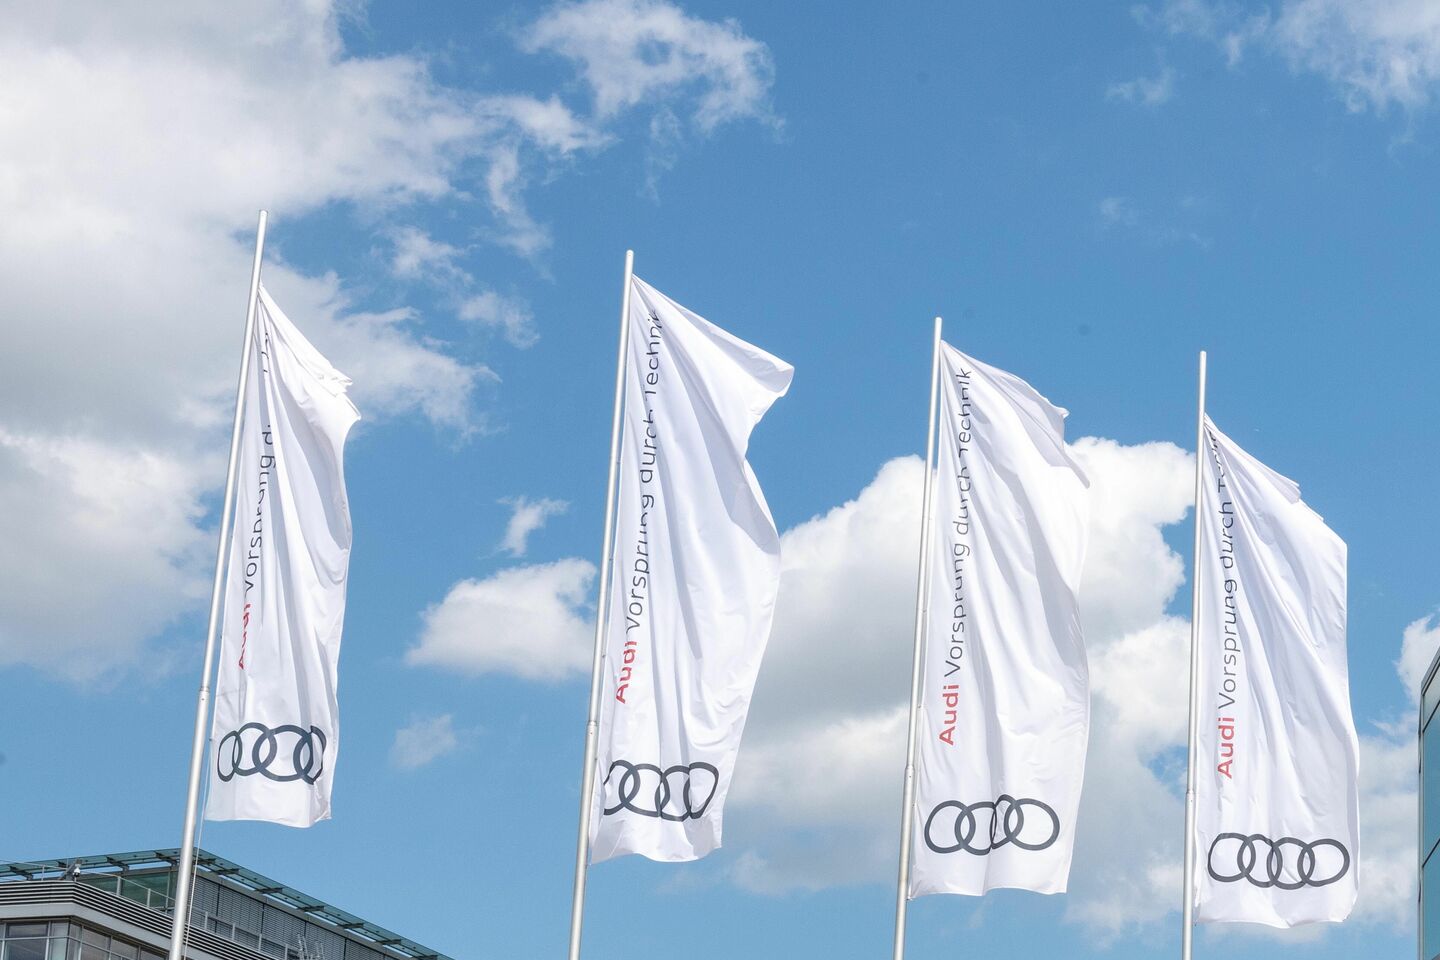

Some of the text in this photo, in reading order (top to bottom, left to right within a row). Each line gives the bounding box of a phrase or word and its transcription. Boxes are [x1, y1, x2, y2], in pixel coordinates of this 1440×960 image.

[953, 466, 971, 535] durch
[625, 494, 655, 634] Vorsprung
[944, 543, 971, 678] Vorsprung
[615, 640, 637, 704] Audi
[1217, 501, 1241, 779] Audi Vorsprung durch
[938, 684, 960, 746] Audi
